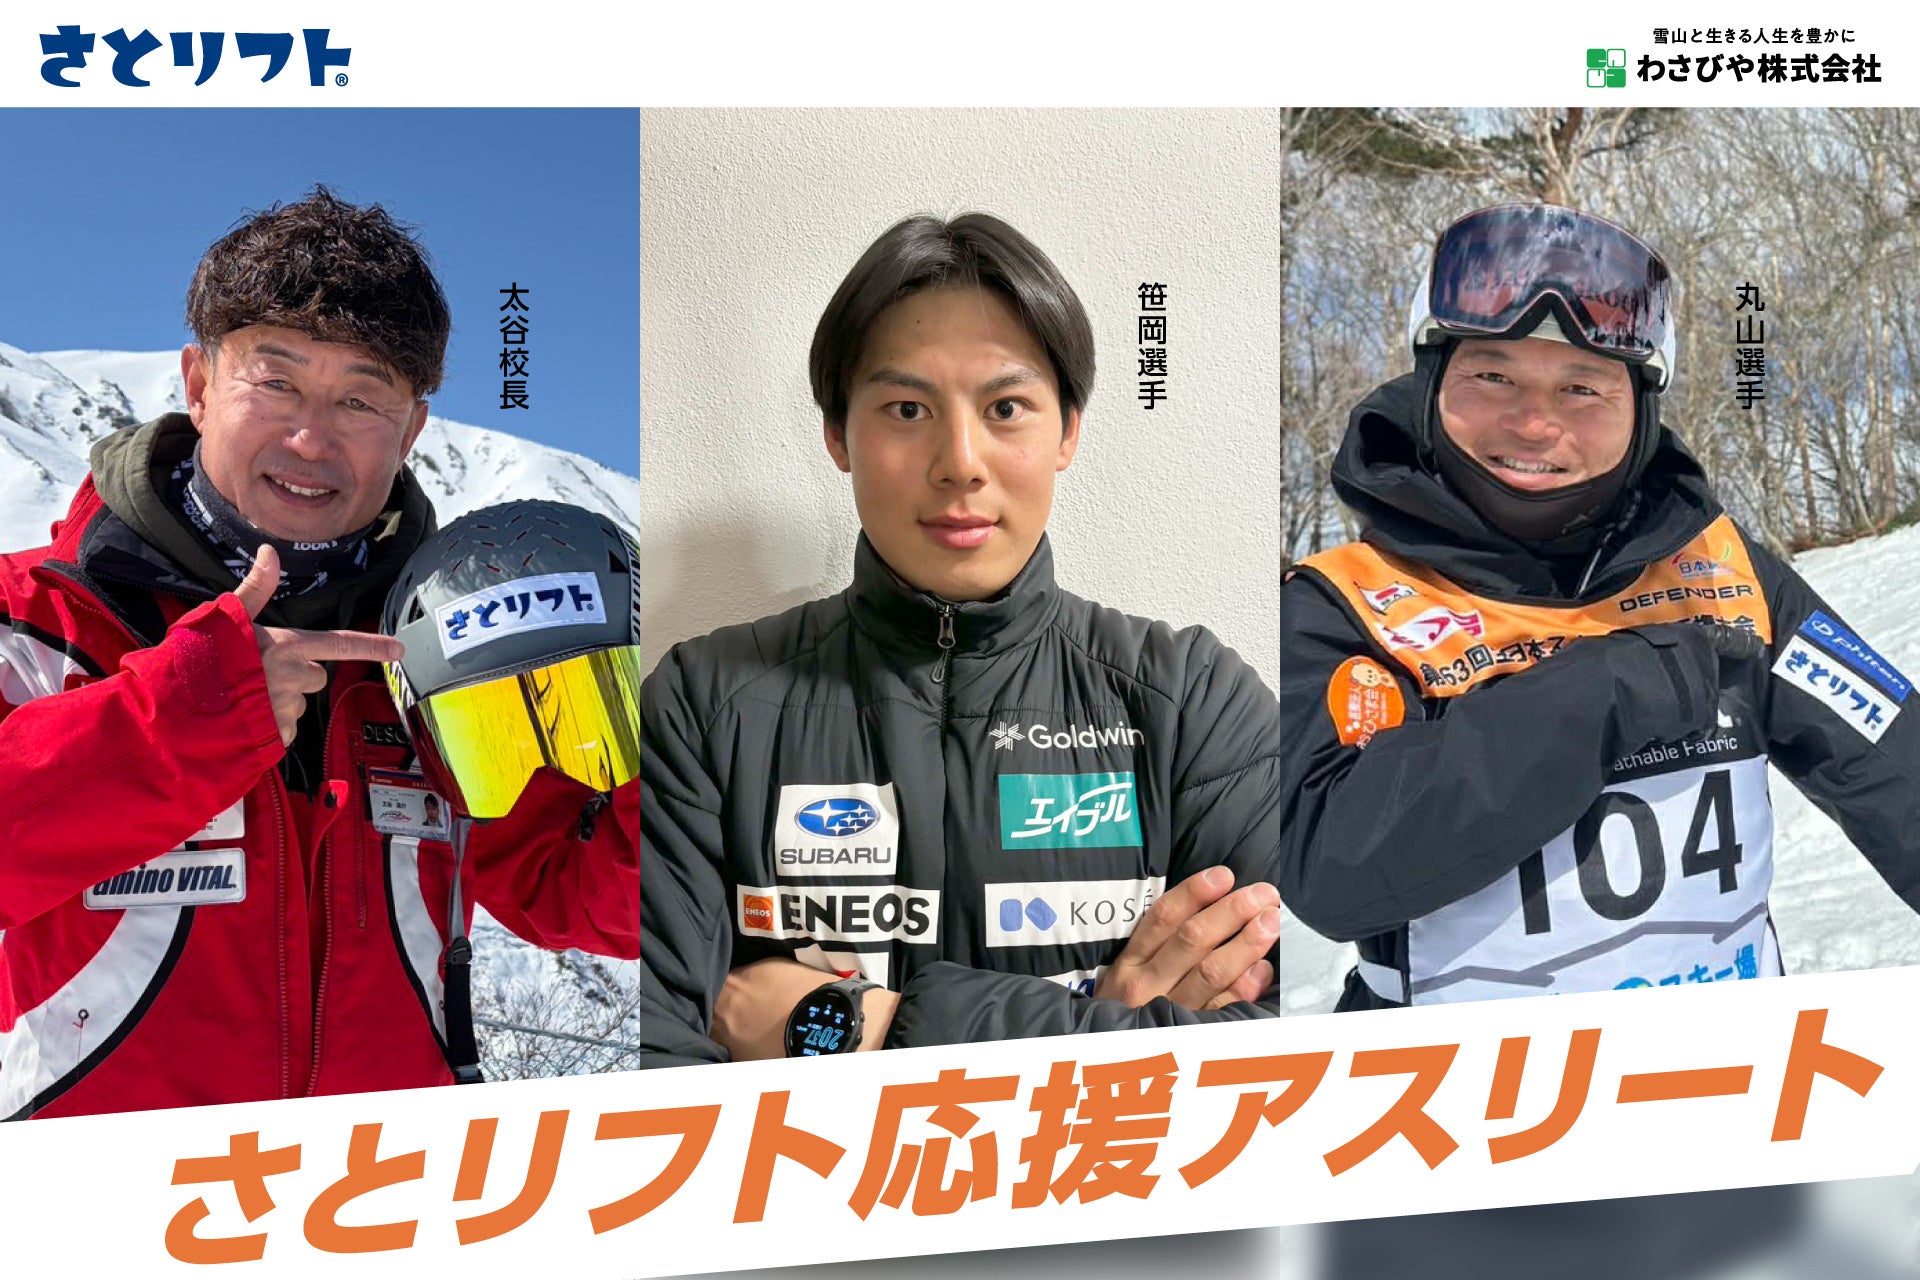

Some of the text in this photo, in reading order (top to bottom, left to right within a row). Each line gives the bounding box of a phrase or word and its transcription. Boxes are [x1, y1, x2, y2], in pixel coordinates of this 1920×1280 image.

[1620, 585, 1754, 612] DEFENDER
[1028, 721, 1145, 749] Goldwin
[1683, 735, 1738, 756] Fabric
[1011, 782, 1133, 838] エイブル
[780, 847, 892, 865] SUBARU
[1518, 769, 1744, 935] 104
[745, 893, 930, 936] ENEOS ENEOS
